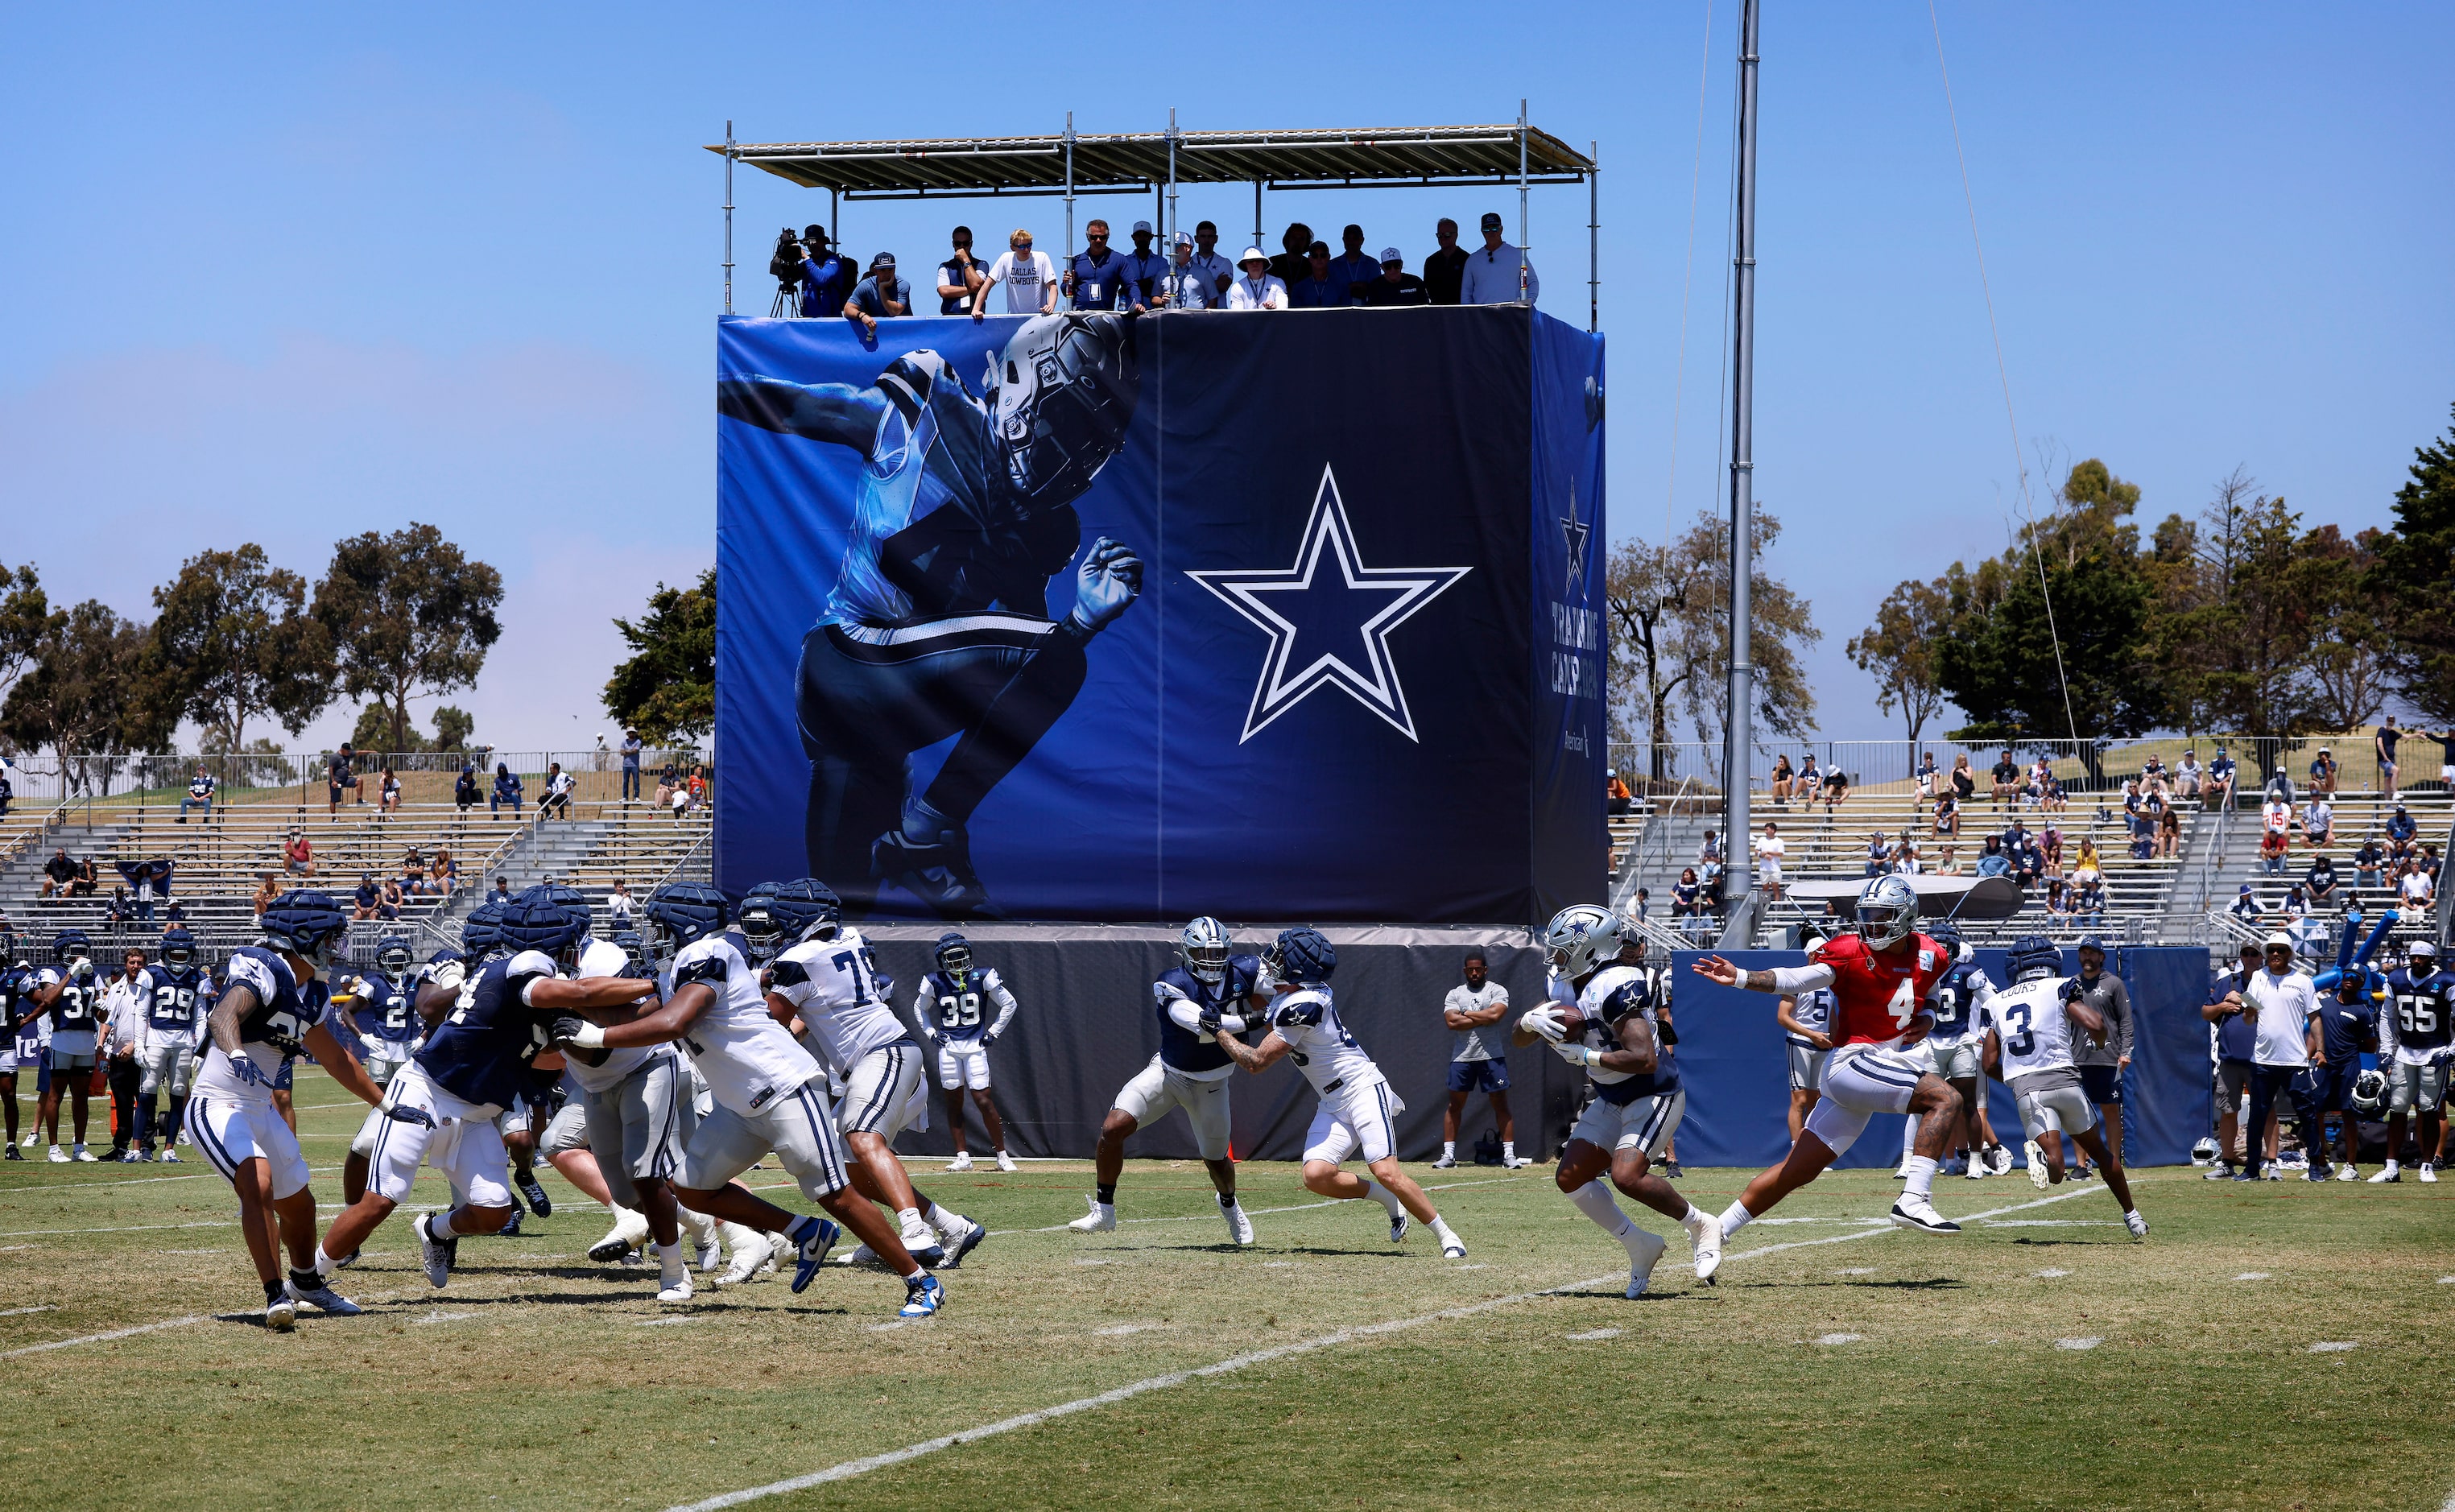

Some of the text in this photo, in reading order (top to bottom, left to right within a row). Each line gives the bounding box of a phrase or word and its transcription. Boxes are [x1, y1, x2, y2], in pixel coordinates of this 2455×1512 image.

[1009, 276, 1039, 285] COWBOYS
[1011, 267, 1037, 276] DALLAS
[1552, 601, 1598, 652] TRAINING
[1552, 651, 1580, 696] CAMP
[1564, 730, 1584, 752] American
[2271, 812, 2283, 826] 15
[63, 986, 96, 1019] 37
[155, 985, 195, 1021] 29
[386, 996, 407, 1028] 2
[940, 992, 981, 1027] 39
[1812, 990, 1829, 1022] 5
[1887, 977, 1916, 1031] 4
[2396, 994, 2437, 1033] 55
[2006, 1002, 2036, 1057] 3
